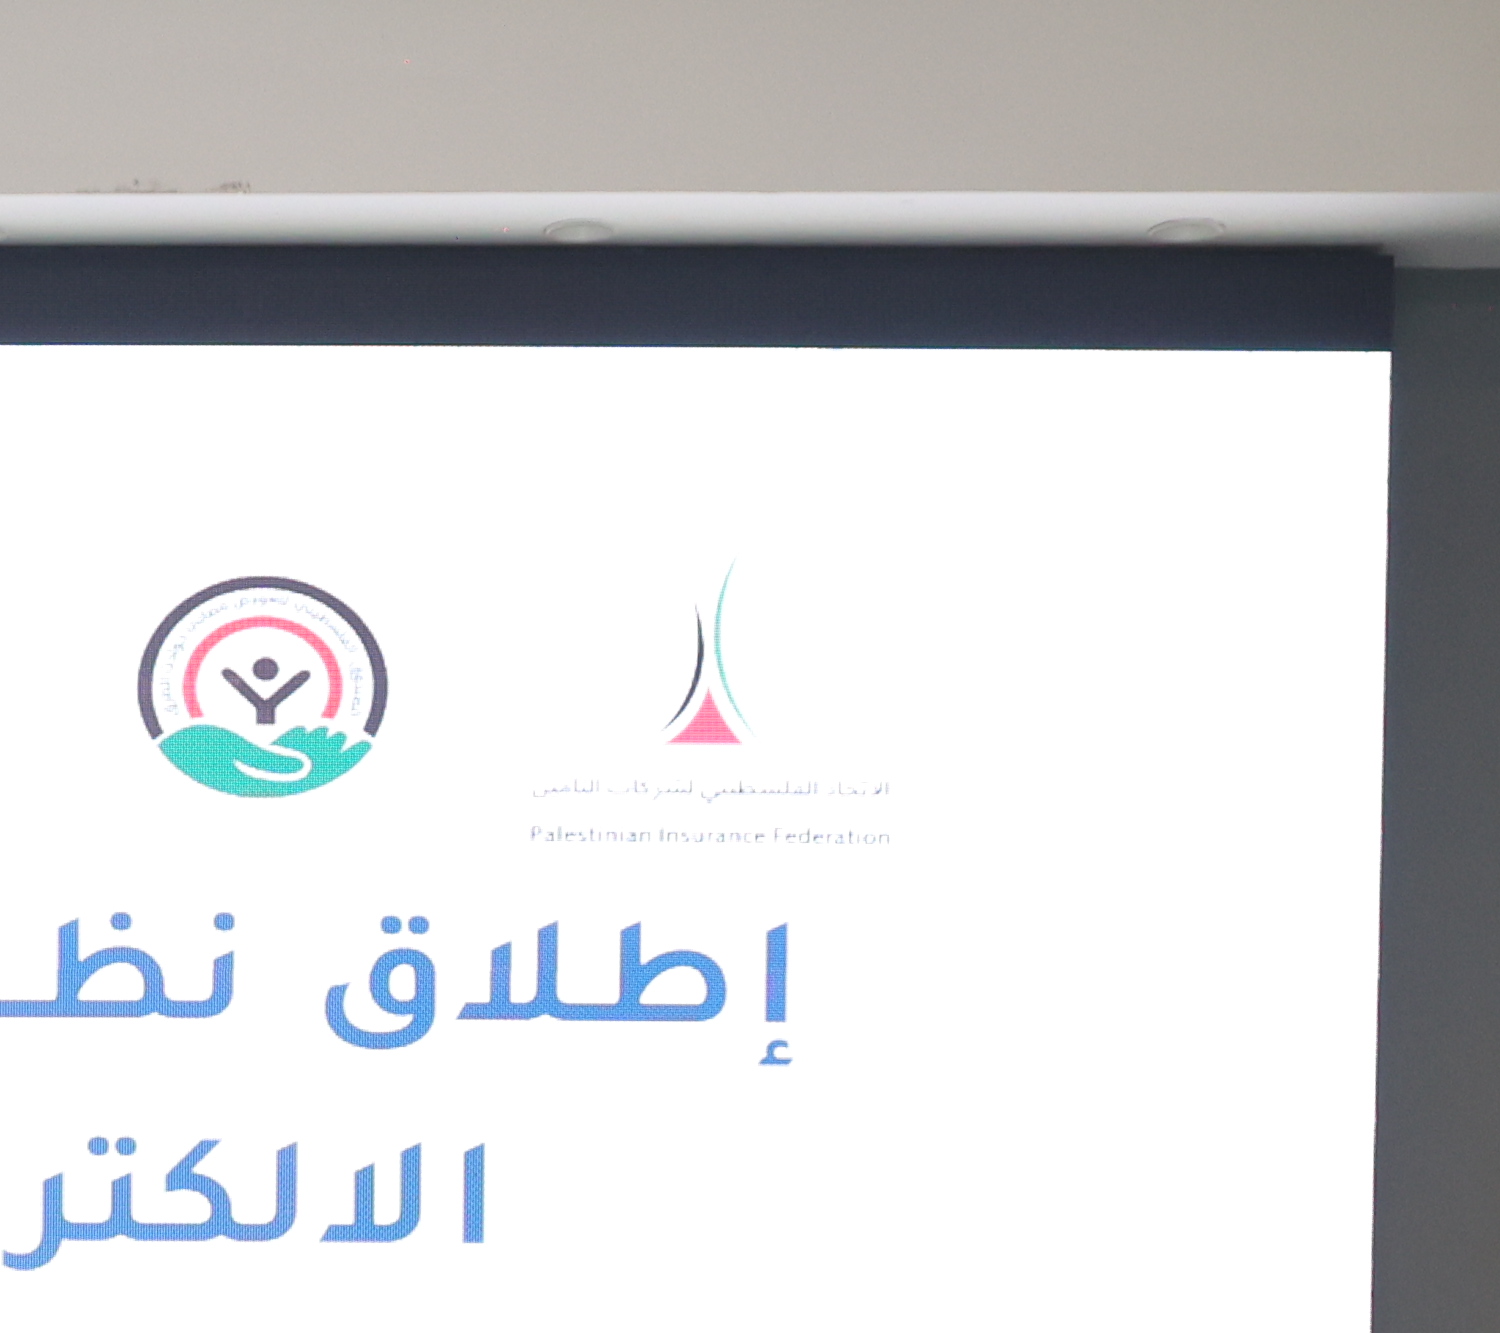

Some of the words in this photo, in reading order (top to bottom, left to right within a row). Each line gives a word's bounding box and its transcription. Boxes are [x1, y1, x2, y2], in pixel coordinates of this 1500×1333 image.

[529, 824, 652, 845] Palestinian
[658, 826, 766, 845] Insurance
[773, 826, 891, 847] Federation
[325, 913, 793, 1067] إطلاق
